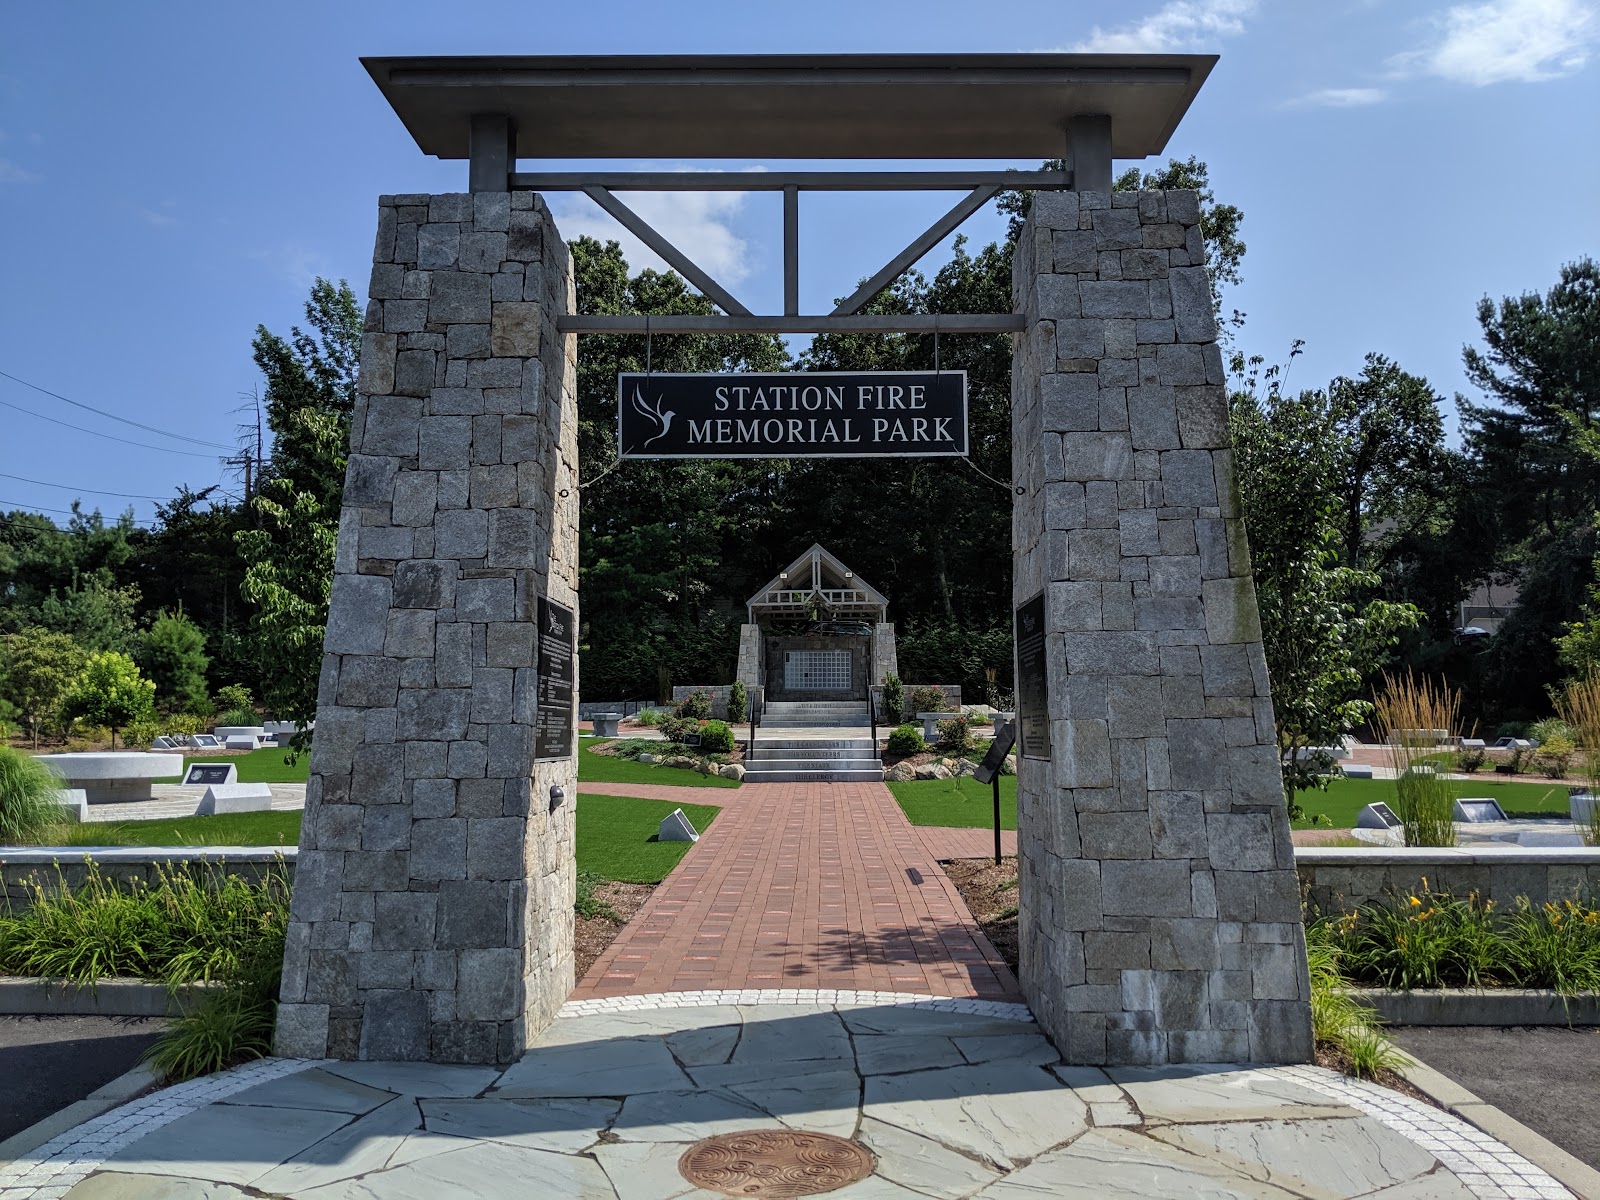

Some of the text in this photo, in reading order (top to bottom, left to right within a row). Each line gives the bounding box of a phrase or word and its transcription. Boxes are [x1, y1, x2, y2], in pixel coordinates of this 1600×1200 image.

[714, 384, 928, 411] STATION FIRE
[687, 417, 955, 444] MEMORIAL PARK
